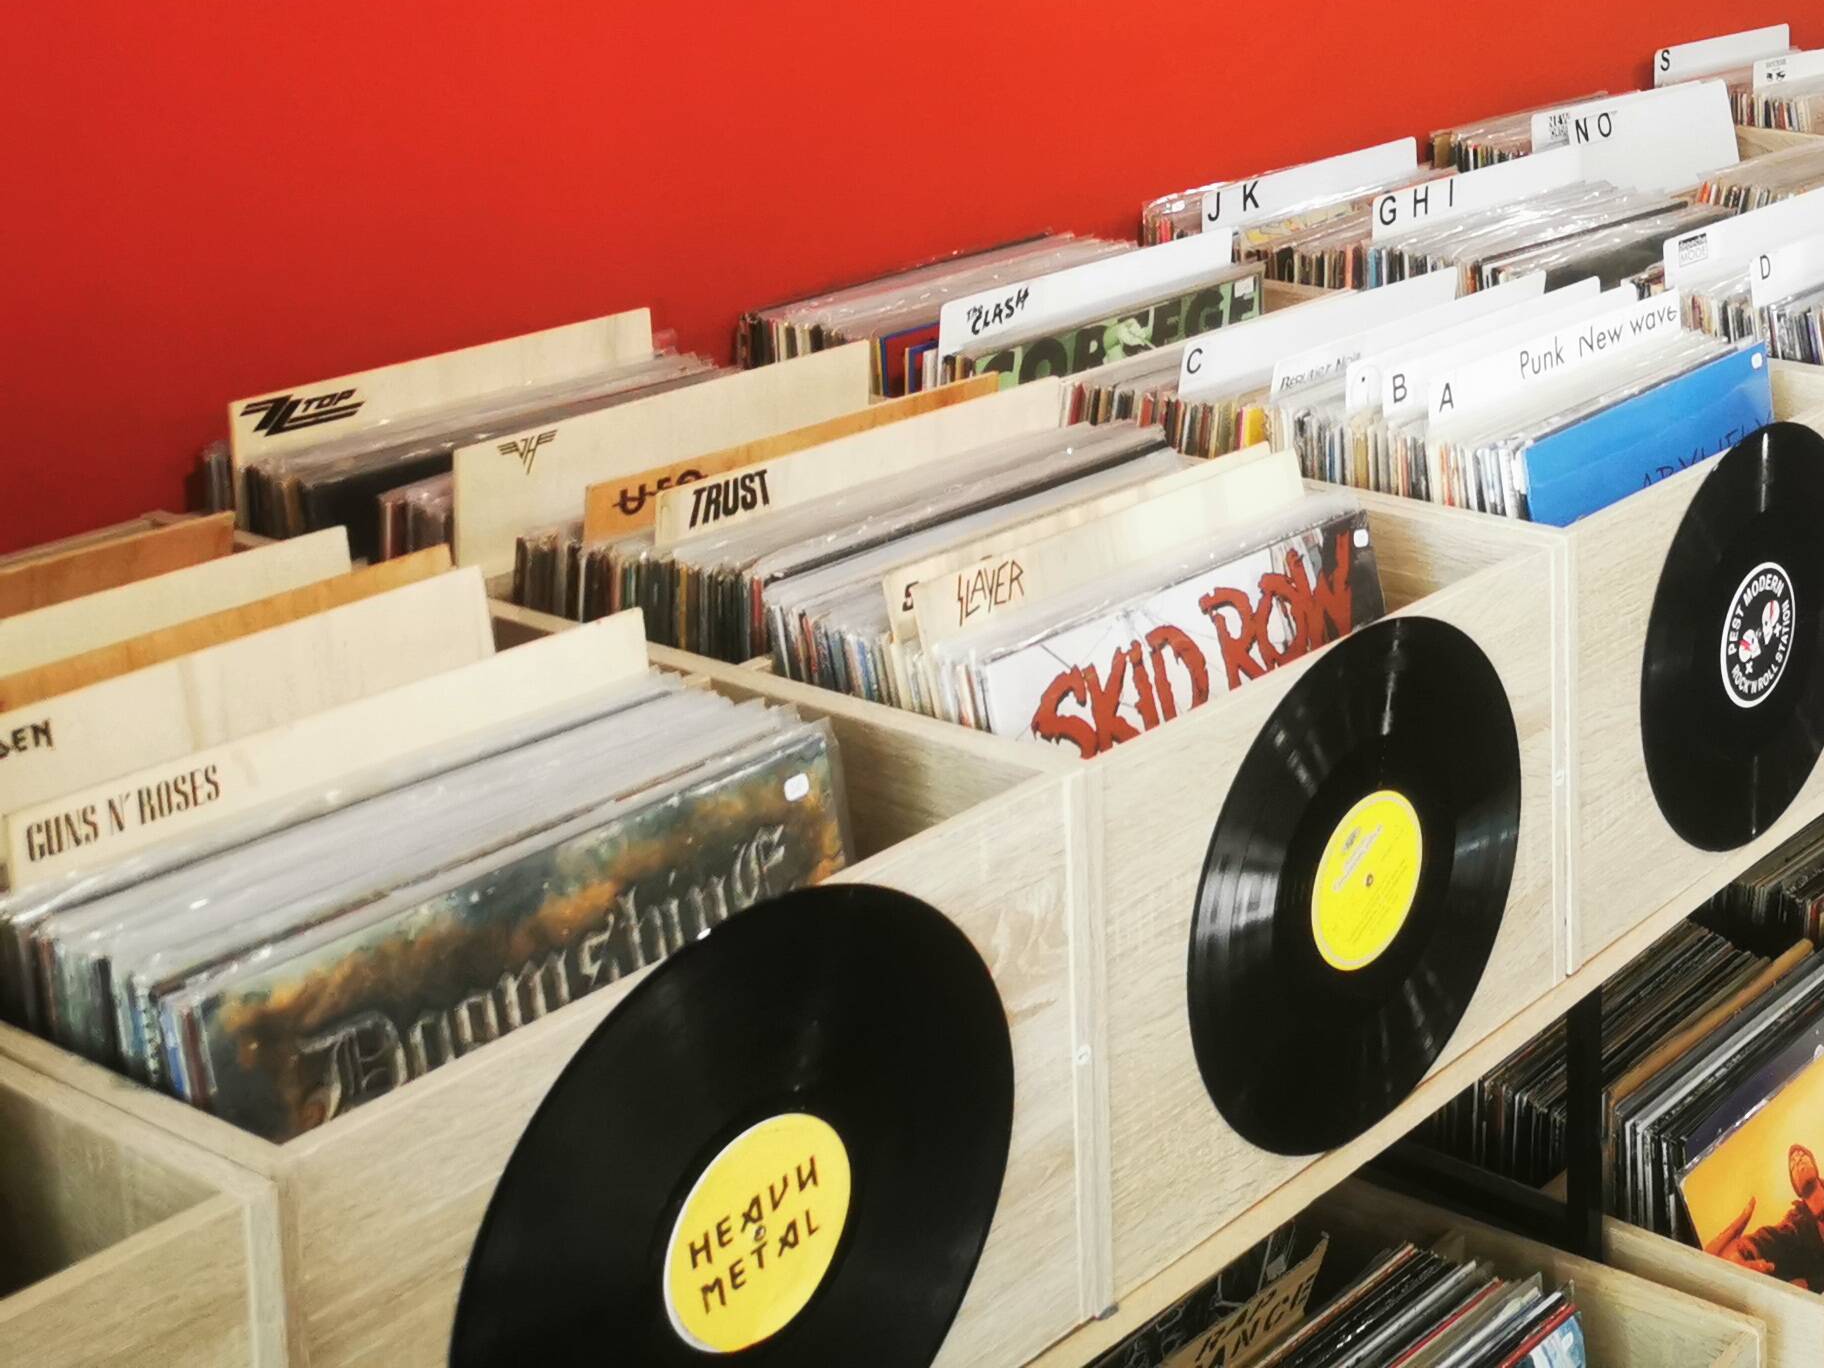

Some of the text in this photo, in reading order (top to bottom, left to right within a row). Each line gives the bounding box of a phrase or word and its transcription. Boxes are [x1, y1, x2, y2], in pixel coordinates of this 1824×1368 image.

[1660, 49, 1671, 72] S
[1575, 117, 1590, 144] N
[1598, 112, 1612, 137] O
[1208, 181, 1261, 222] J K
[1379, 178, 1455, 226] G H I
[1760, 254, 1771, 280] D
[971, 286, 1030, 336] CLASH
[1187, 348, 1203, 374] C
[1518, 304, 1679, 380] Punk New wave
[300, 389, 357, 413] TOP
[1393, 373, 1407, 404] B
[1438, 381, 1455, 413] A
[689, 469, 770, 530] TRUST
[957, 560, 1024, 627] SLAYER
[1199, 531, 1353, 691] ROW
[1728, 573, 1785, 656] PEST MODERN
[1775, 599, 1790, 664] STATION
[1030, 625, 1209, 759] SKID
[26, 805, 99, 862] GUNS
[137, 764, 221, 825] ROSES
[700, 1208, 820, 1316] METAL
[1196, 1272, 1318, 1368] ANCE
